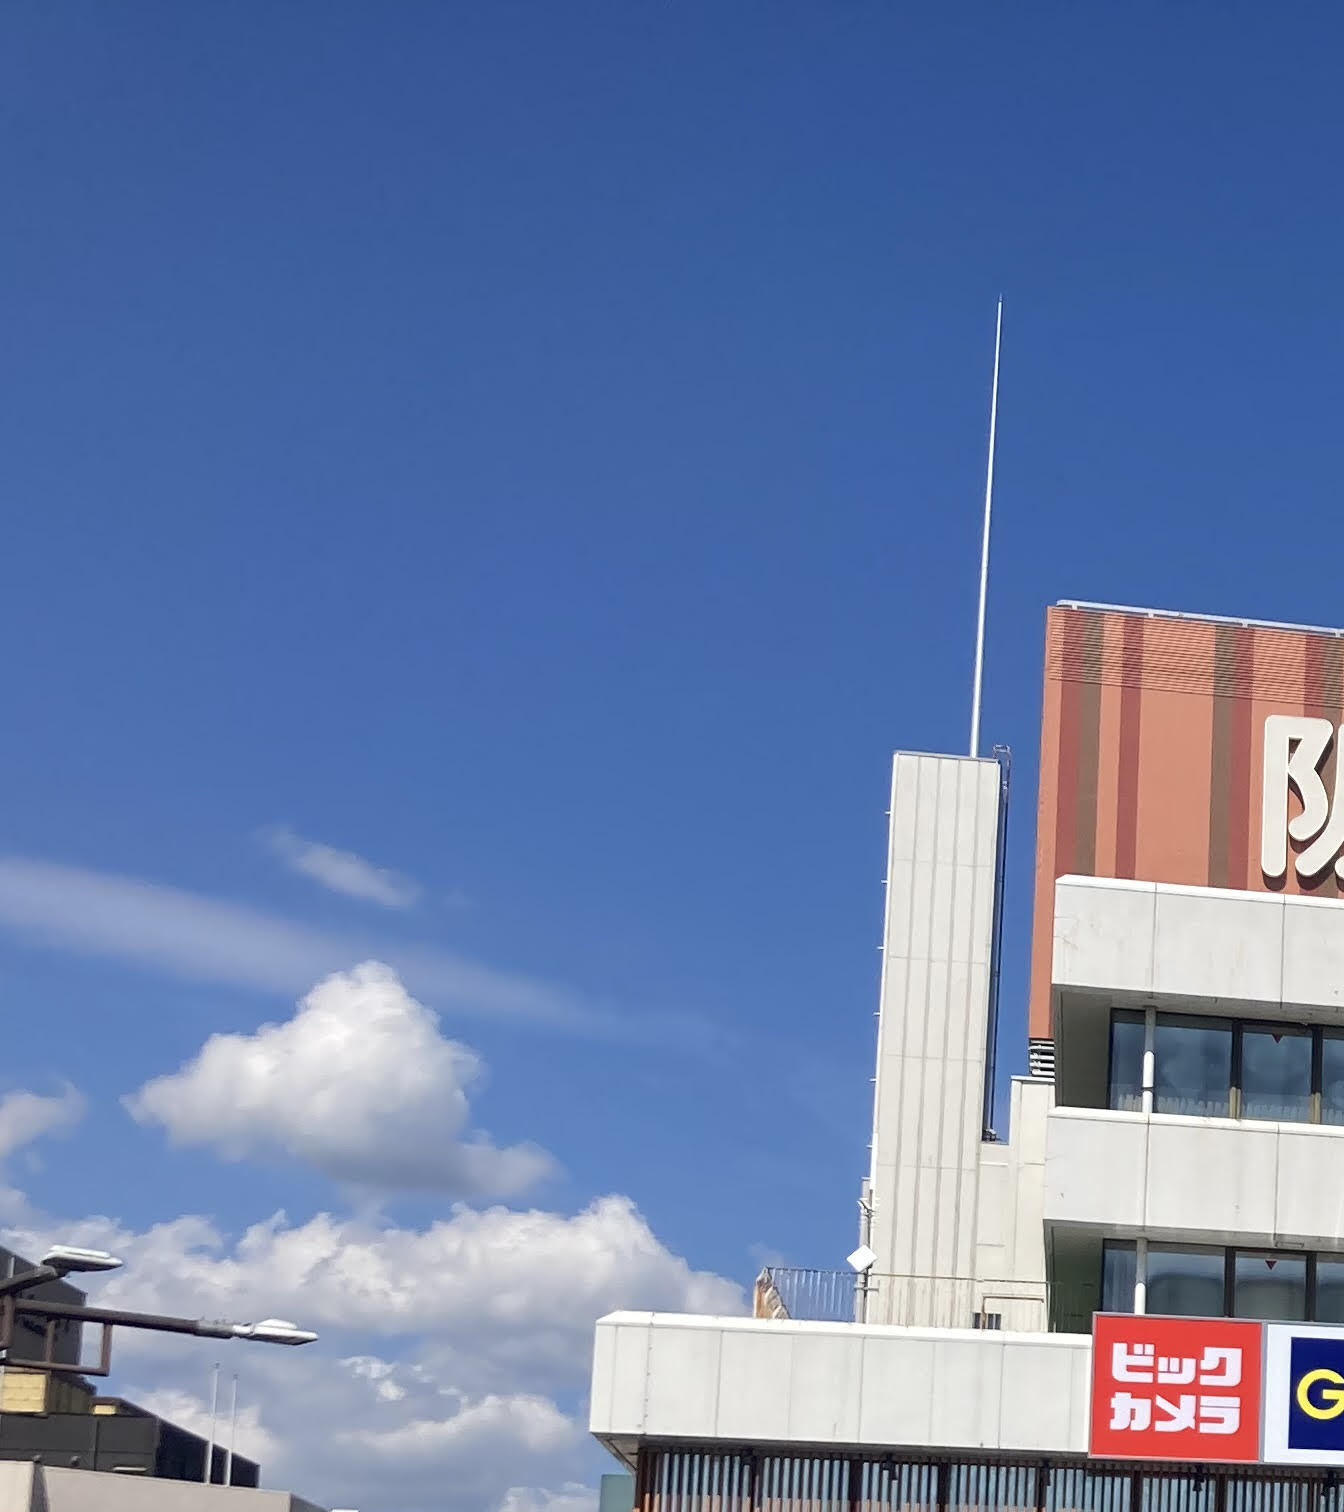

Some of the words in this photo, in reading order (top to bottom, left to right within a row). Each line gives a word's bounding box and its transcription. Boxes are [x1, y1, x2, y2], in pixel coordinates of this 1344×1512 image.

[1111, 1341, 1242, 1387] ビック
[1109, 1391, 1242, 1436] カメラ
